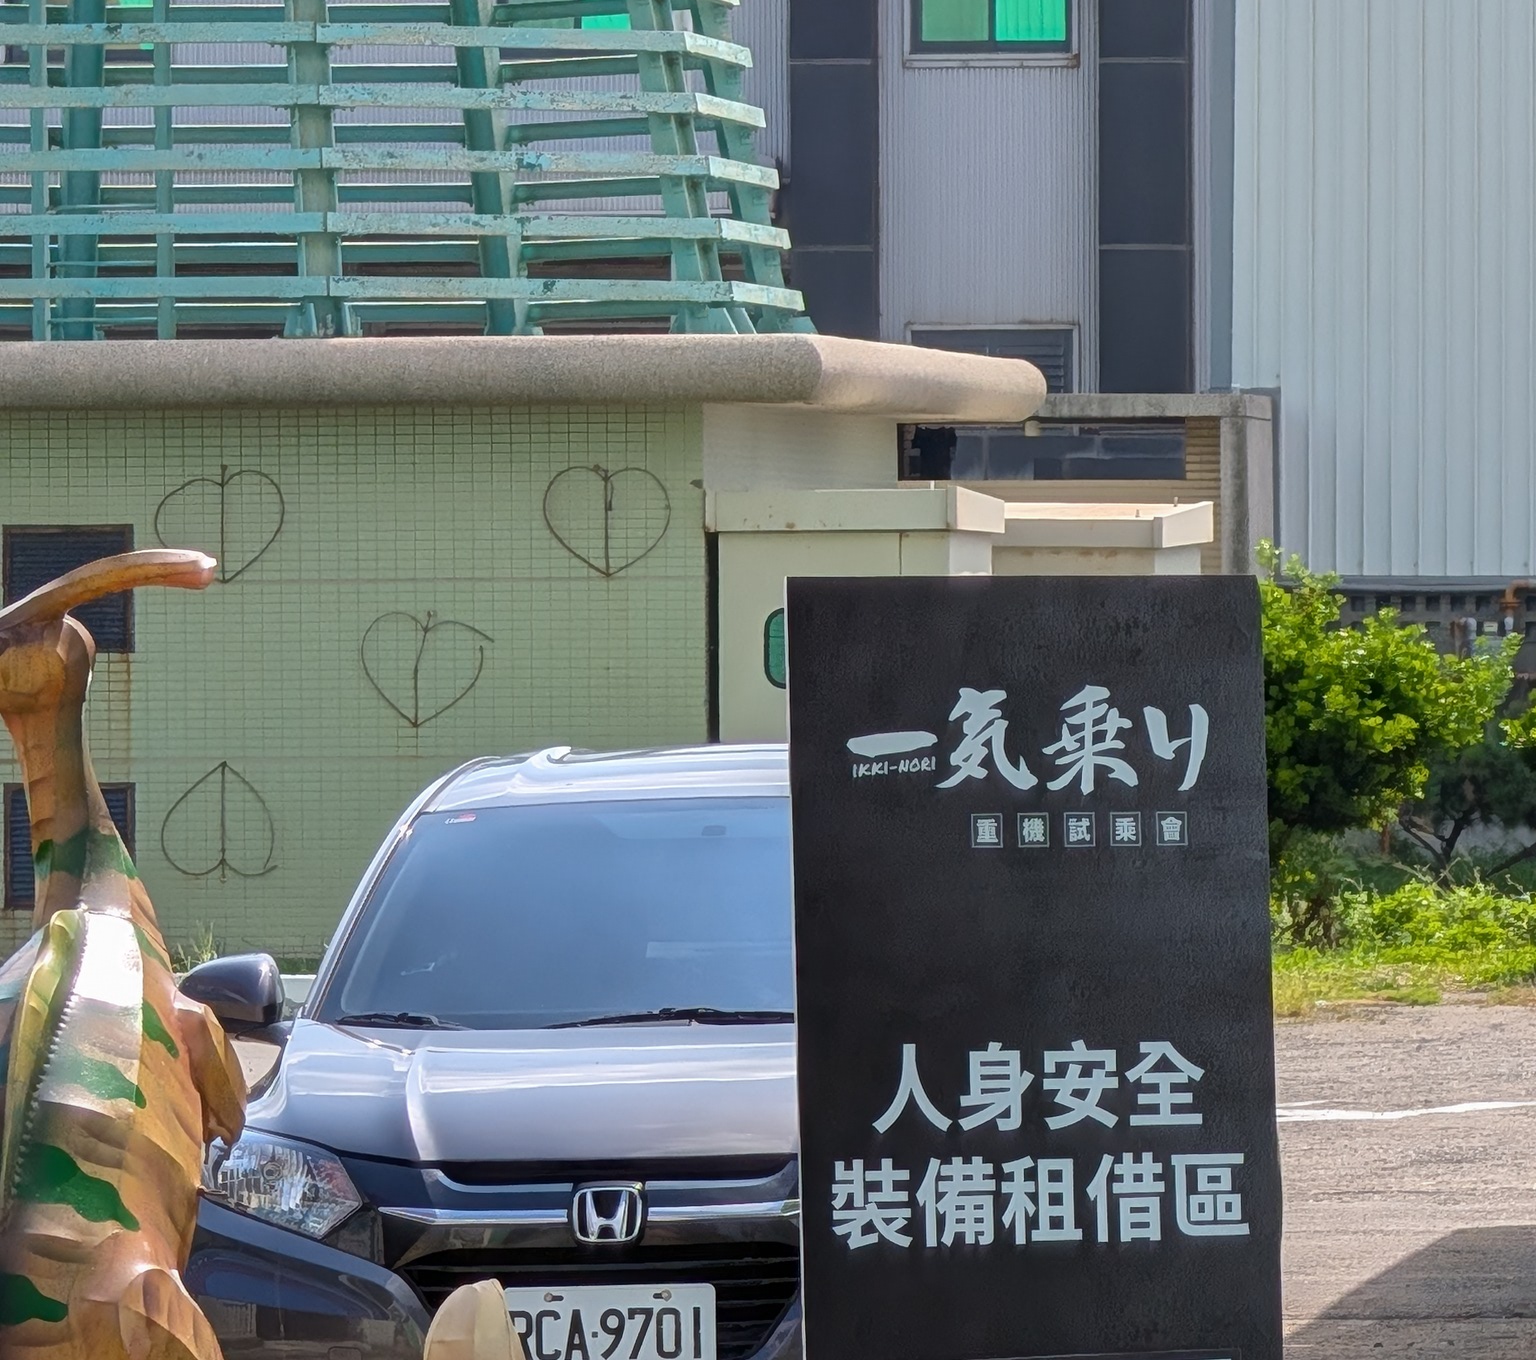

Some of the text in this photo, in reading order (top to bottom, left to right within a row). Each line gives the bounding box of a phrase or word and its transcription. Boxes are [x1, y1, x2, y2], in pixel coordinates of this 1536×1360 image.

[852, 756, 936, 778] IKKI-NORI
[872, 1040, 1205, 1135] 人身安全
[831, 1152, 1251, 1250] 裝備租借區
